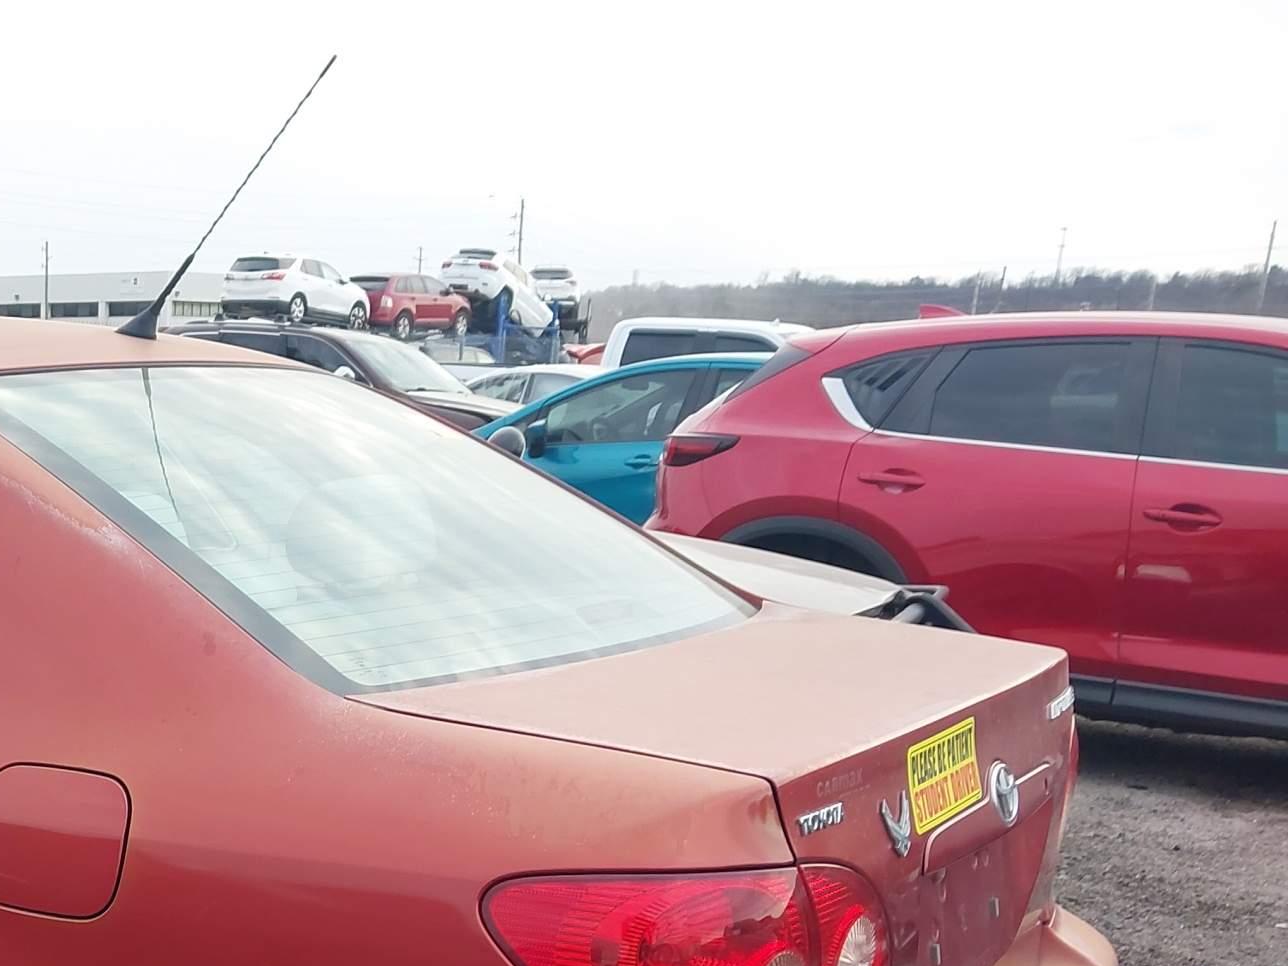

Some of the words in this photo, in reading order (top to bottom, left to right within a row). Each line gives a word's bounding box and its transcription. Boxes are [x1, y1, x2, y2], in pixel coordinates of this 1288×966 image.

[911, 745, 937, 788] PLEASE
[937, 741, 947, 776] BE
[947, 726, 974, 769] PATIENT
[914, 776, 951, 823] STUDENT
[950, 762, 981, 803] DRIVER
